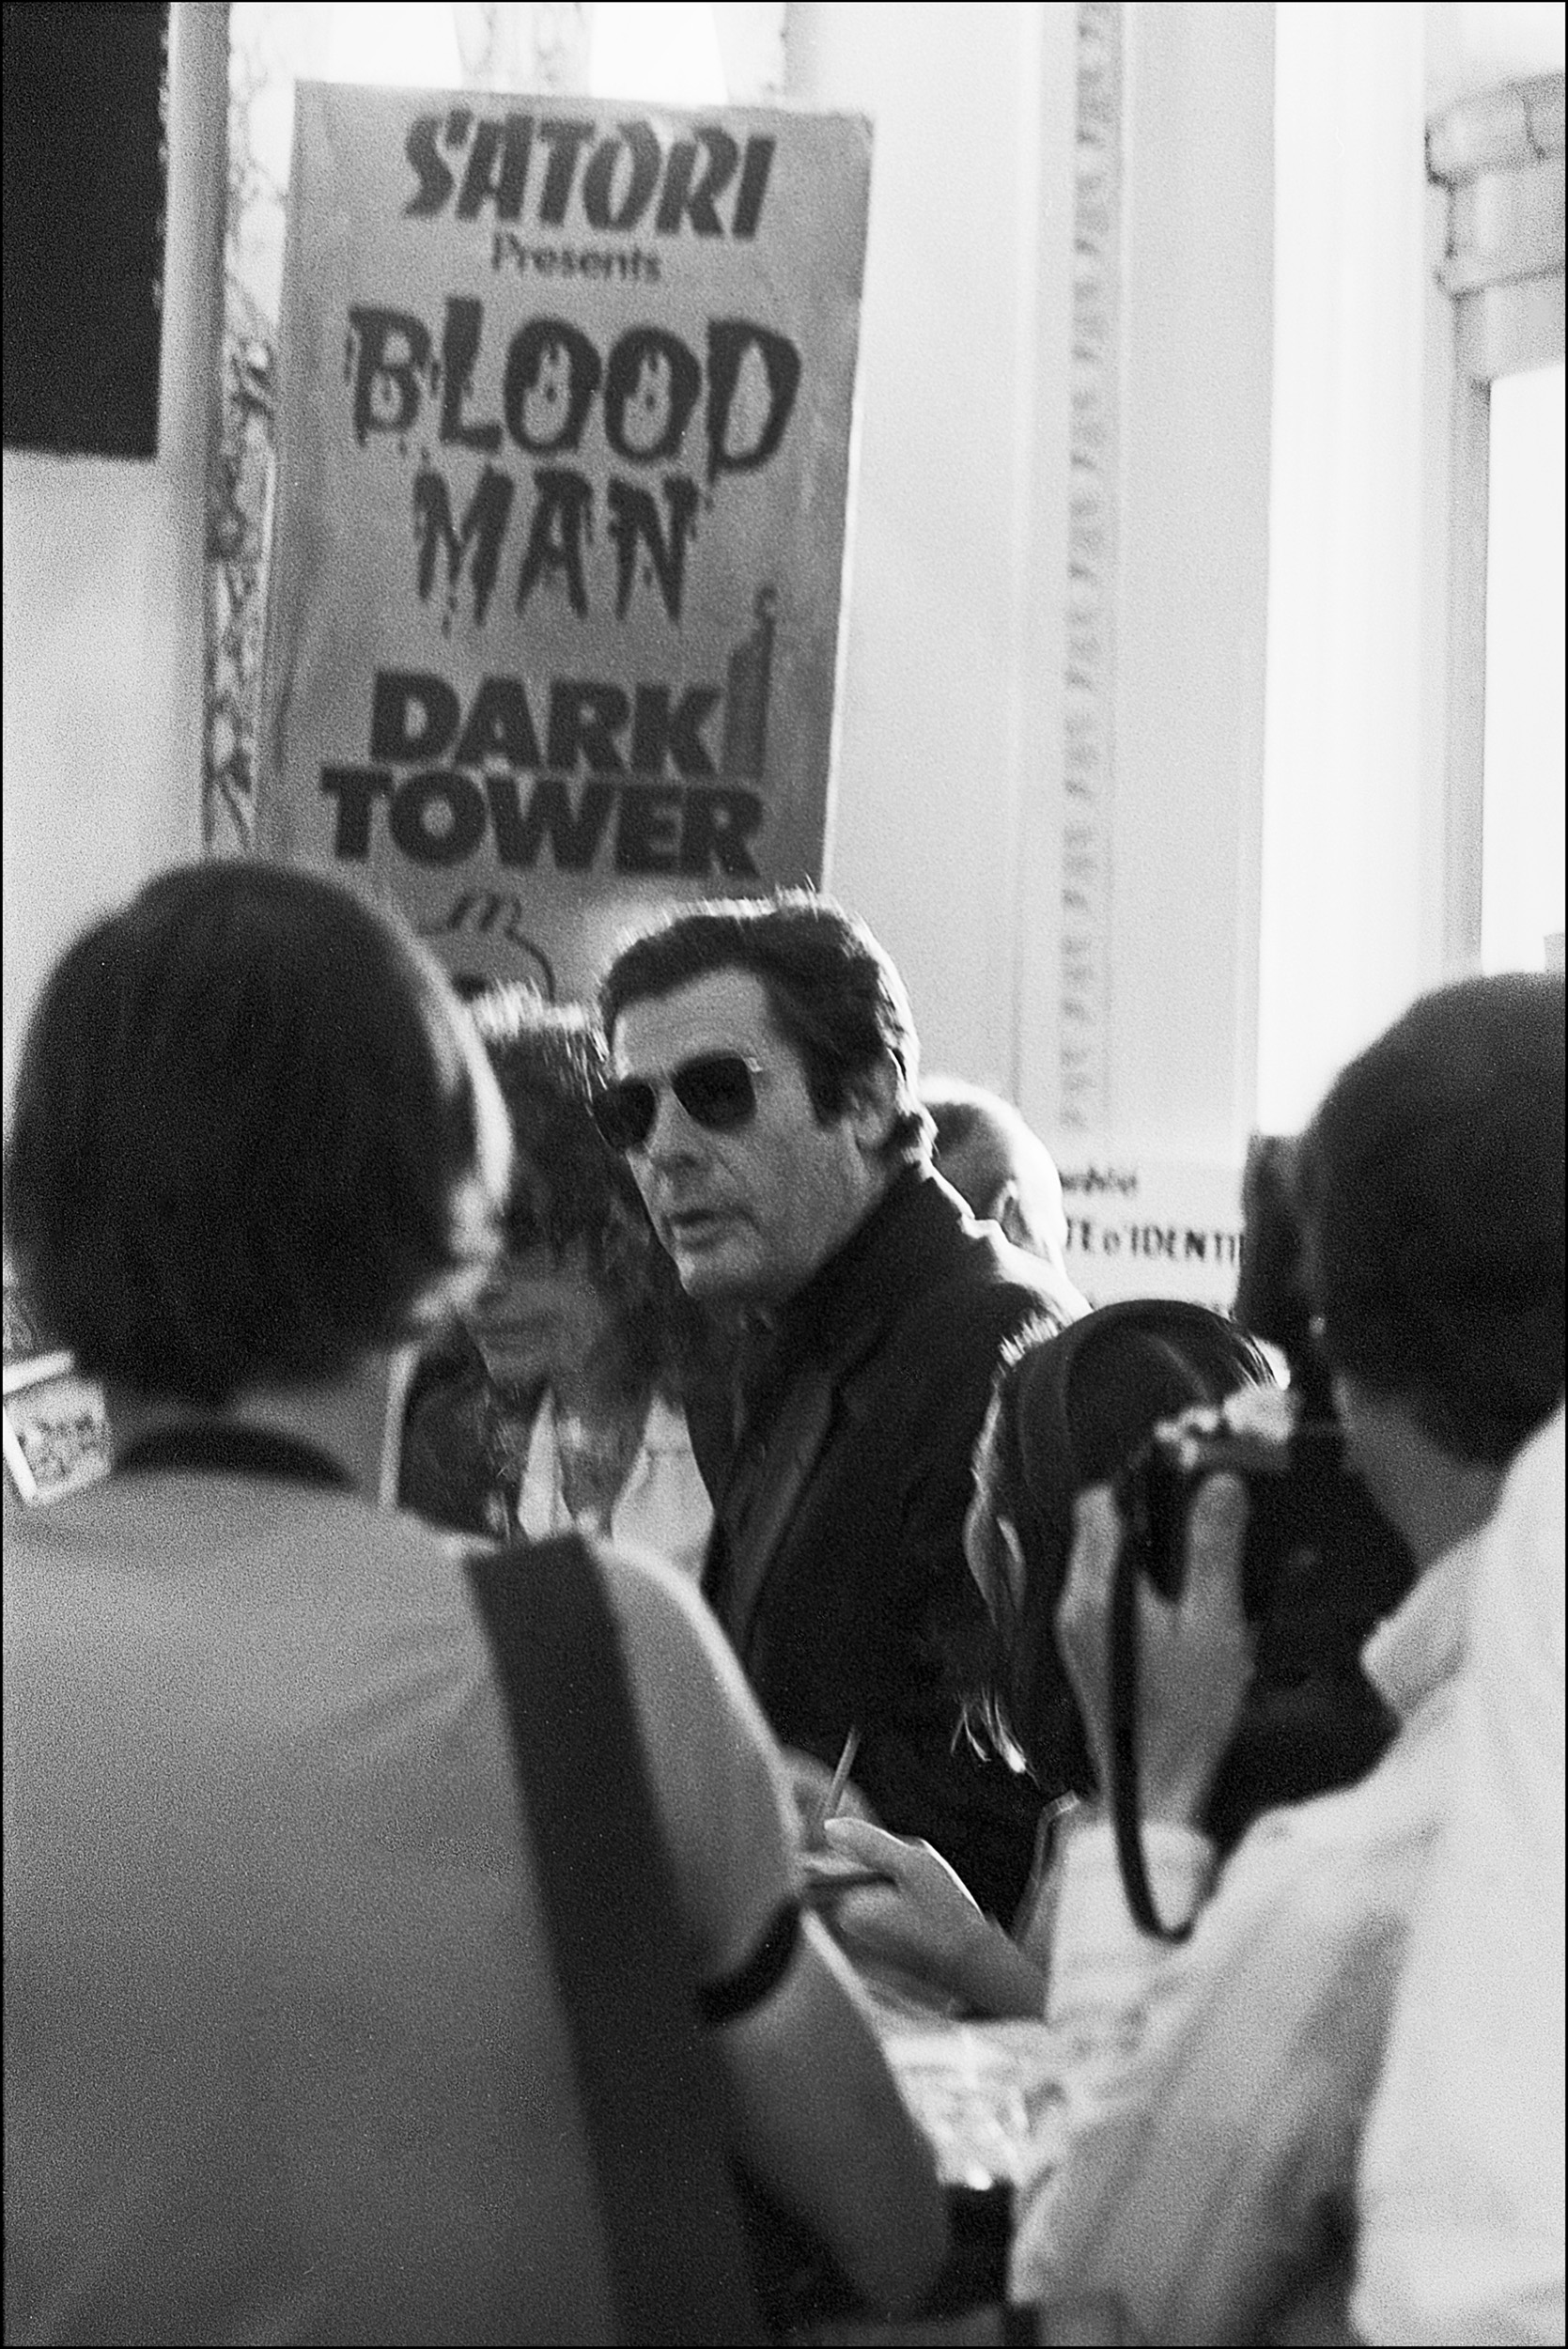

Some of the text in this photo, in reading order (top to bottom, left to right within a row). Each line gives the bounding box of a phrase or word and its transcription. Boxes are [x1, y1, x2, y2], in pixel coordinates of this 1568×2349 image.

[402, 109, 777, 241] SATORI
[490, 231, 663, 284] Presents
[343, 297, 802, 487] BLOOD
[413, 467, 703, 634] MAN
[371, 671, 722, 778] DARK
[320, 767, 764, 879] TOWER
